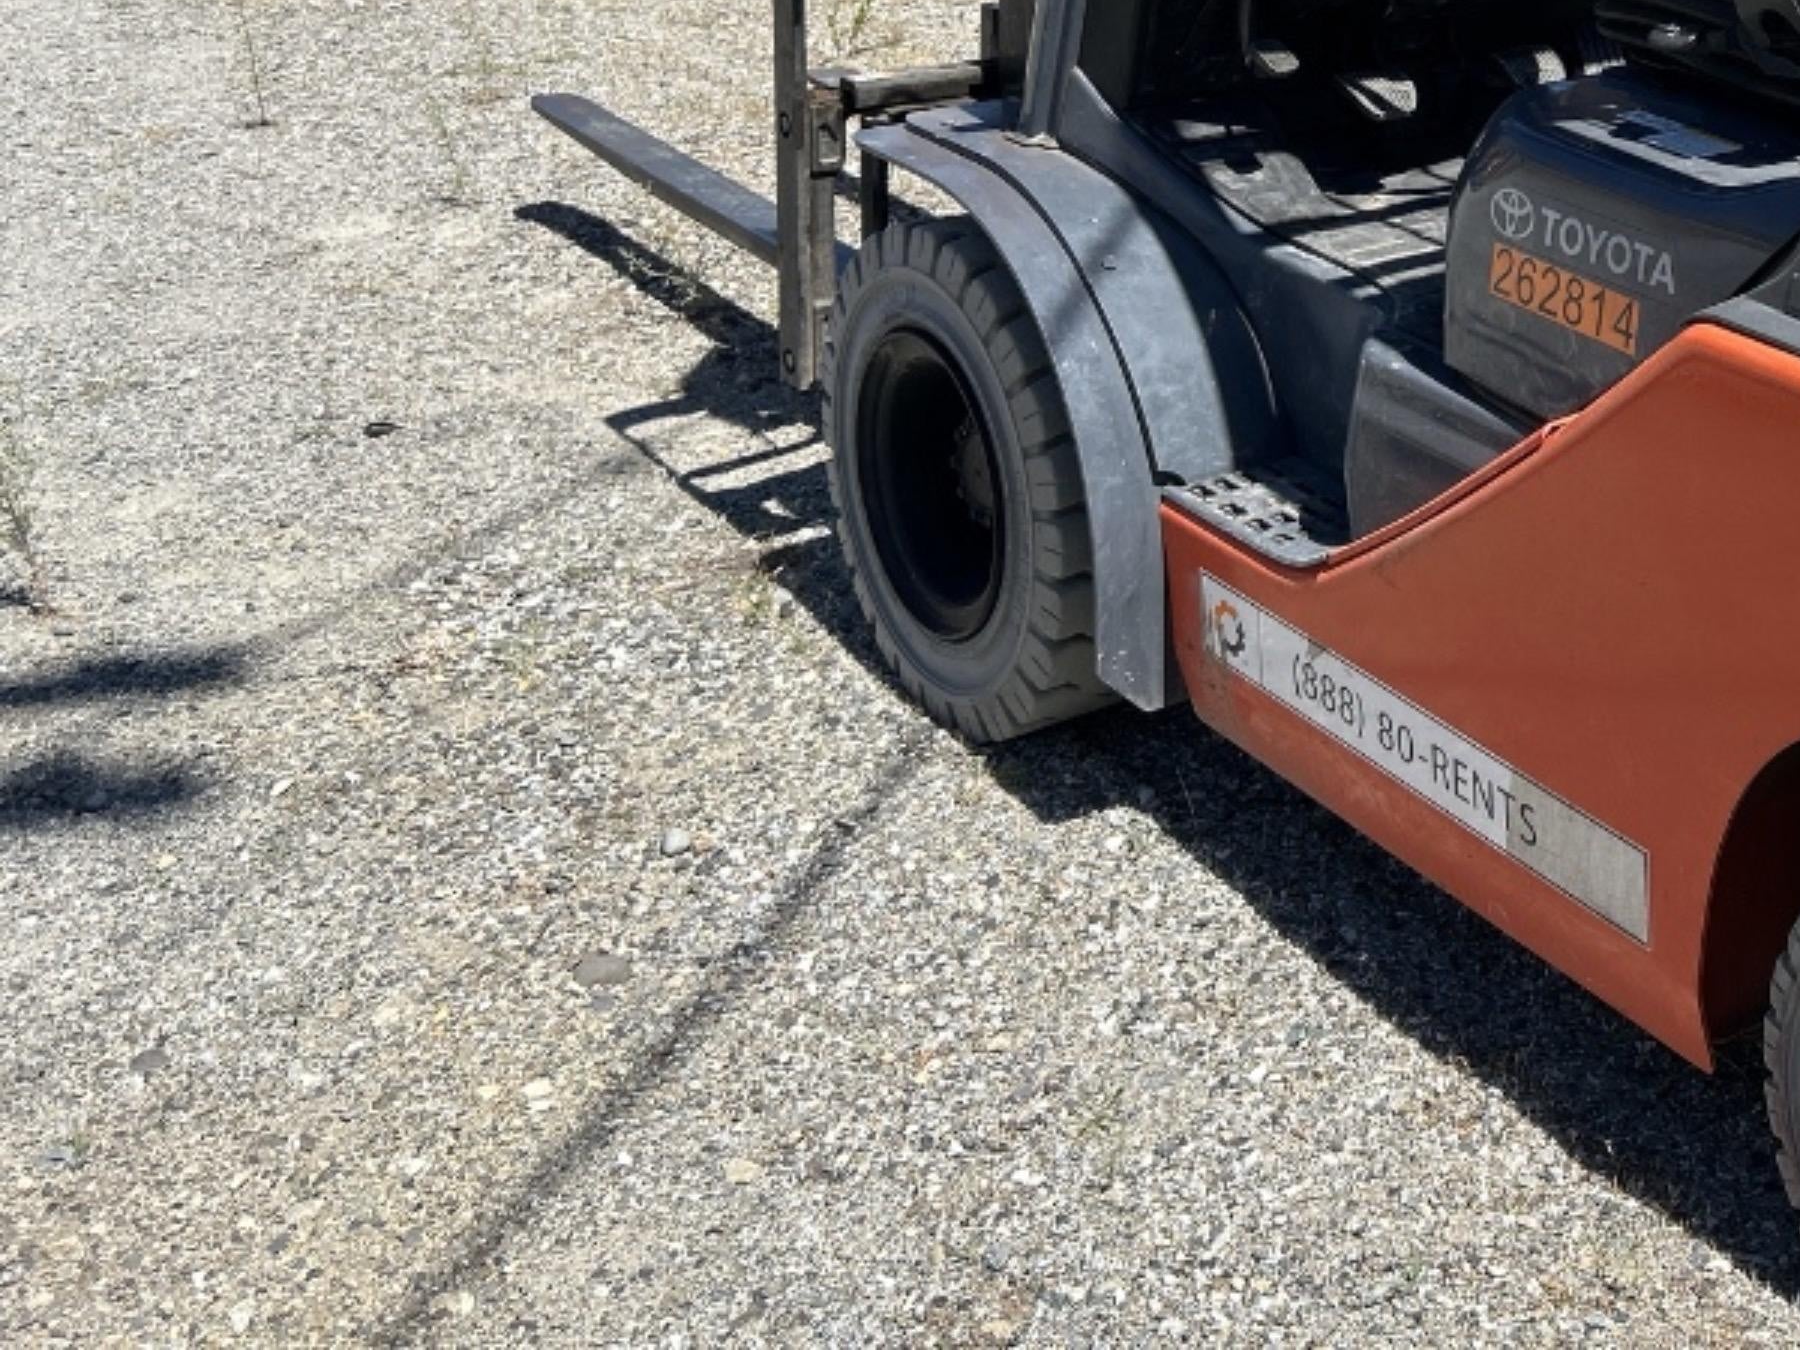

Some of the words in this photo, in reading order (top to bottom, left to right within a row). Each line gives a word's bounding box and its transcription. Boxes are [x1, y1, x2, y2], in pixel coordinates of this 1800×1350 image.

[1493, 248, 1635, 349] 262814
[1541, 206, 1676, 295] TOYOTA
[1291, 653, 1366, 739] (888)
[1376, 712, 1539, 847] 80-RENTS
